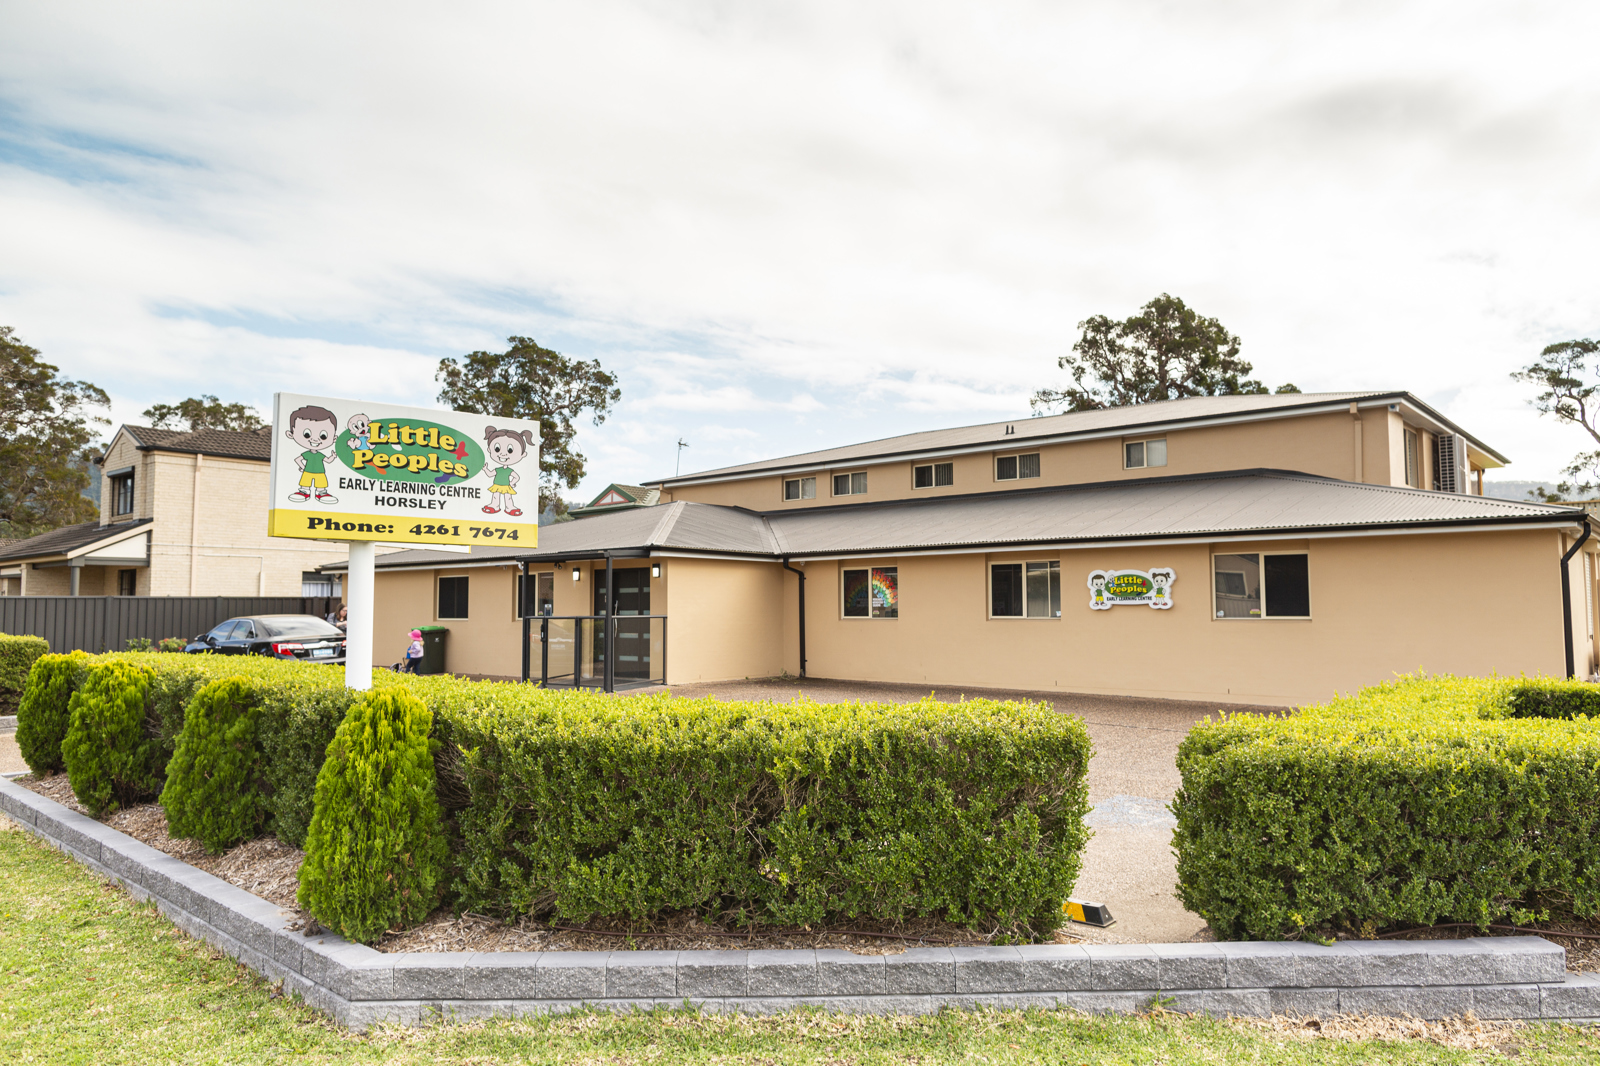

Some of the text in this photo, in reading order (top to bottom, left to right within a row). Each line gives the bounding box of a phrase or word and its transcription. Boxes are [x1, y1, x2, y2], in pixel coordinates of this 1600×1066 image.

[368, 422, 457, 452] Little
[351, 449, 469, 479] Peoples
[339, 477, 481, 499] EARLY LEARNING CENTRE
[374, 495, 447, 510] HORSLEY
[307, 517, 519, 541] Phone: 4261 7674
[1110, 586, 1147, 594] Peoples
[1114, 576, 1142, 585] Little
